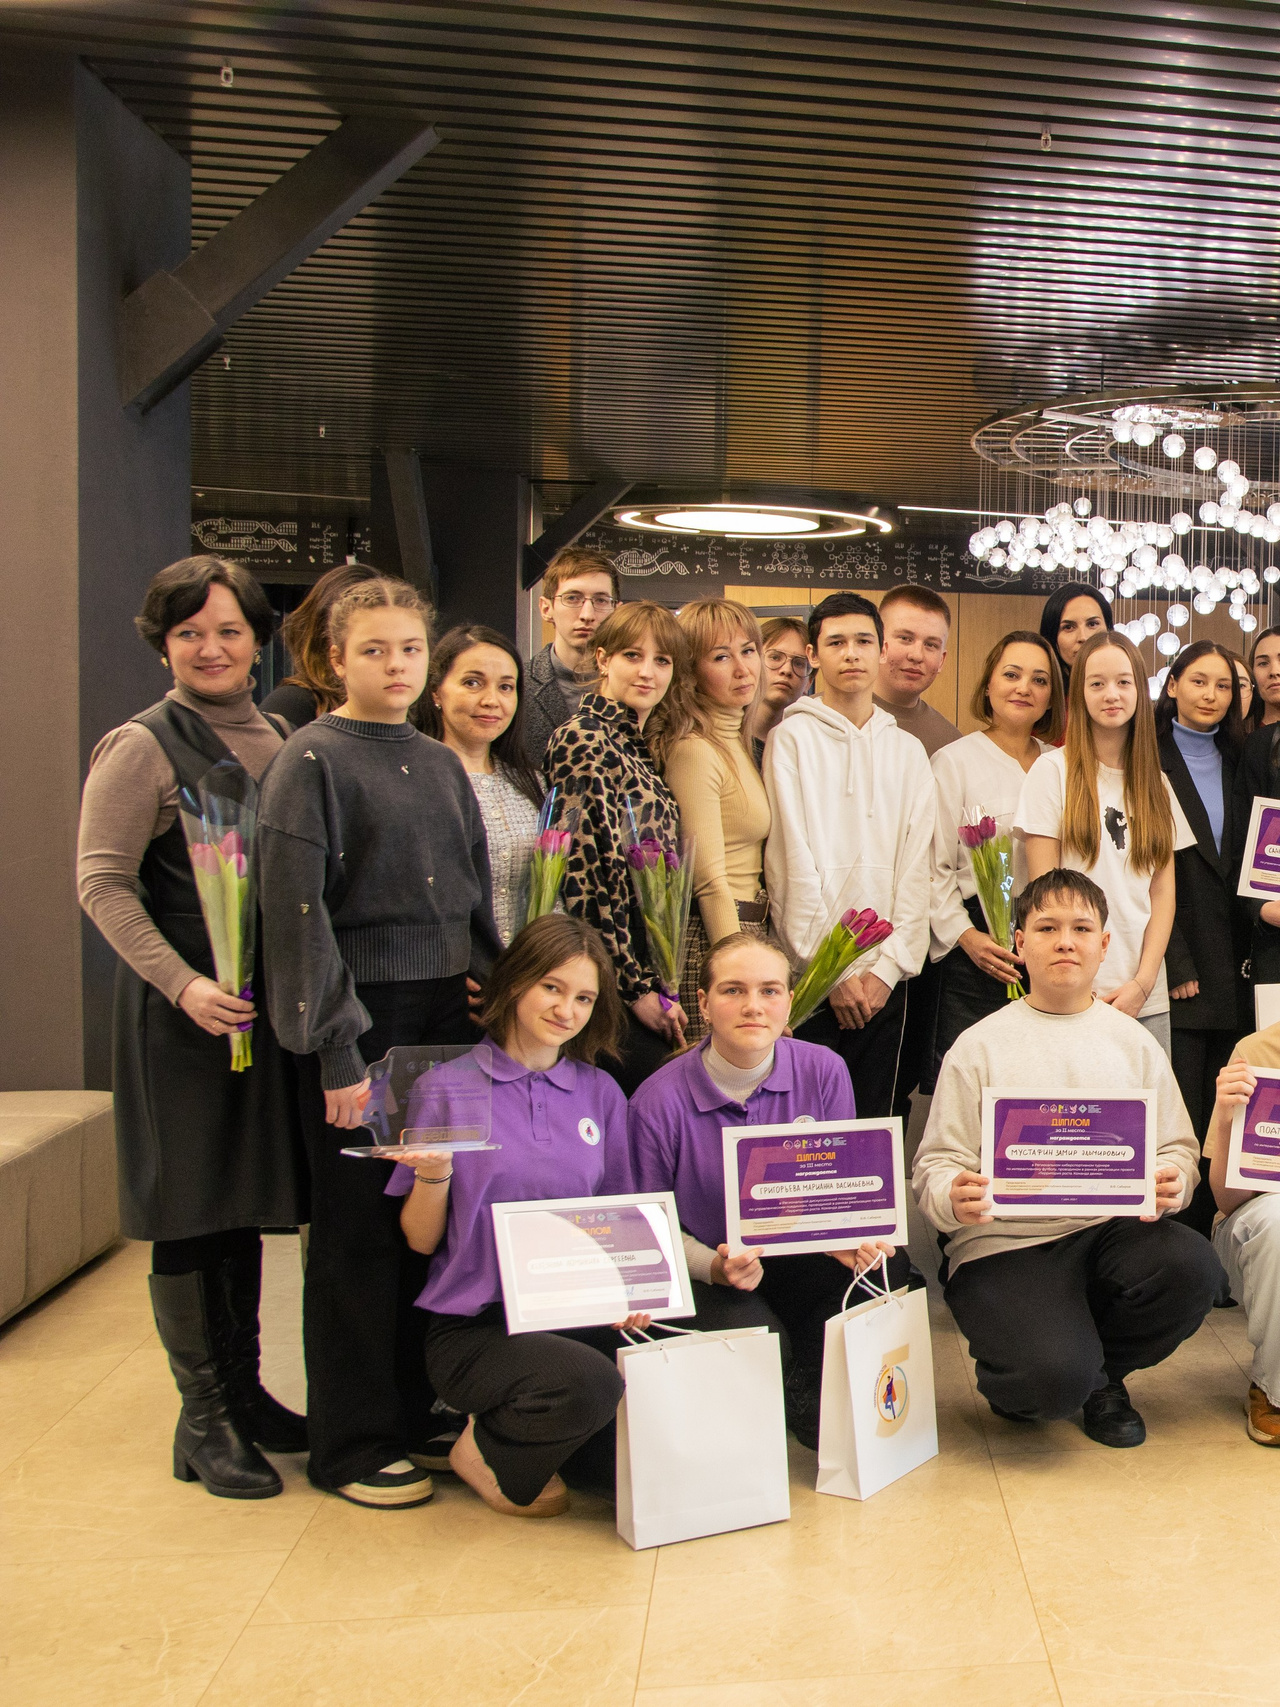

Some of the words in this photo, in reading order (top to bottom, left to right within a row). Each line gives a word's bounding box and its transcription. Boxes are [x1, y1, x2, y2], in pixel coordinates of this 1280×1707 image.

[1051, 1118, 1090, 1126] ДИПЛОМ
[795, 1151, 835, 1161] ДИПЛОМ
[759, 1184, 800, 1194] ГРИГОРЬЕВА
[802, 1182, 833, 1190] МАРИАННА
[836, 1178, 874, 1189] ВАСИЛЬЕВНА
